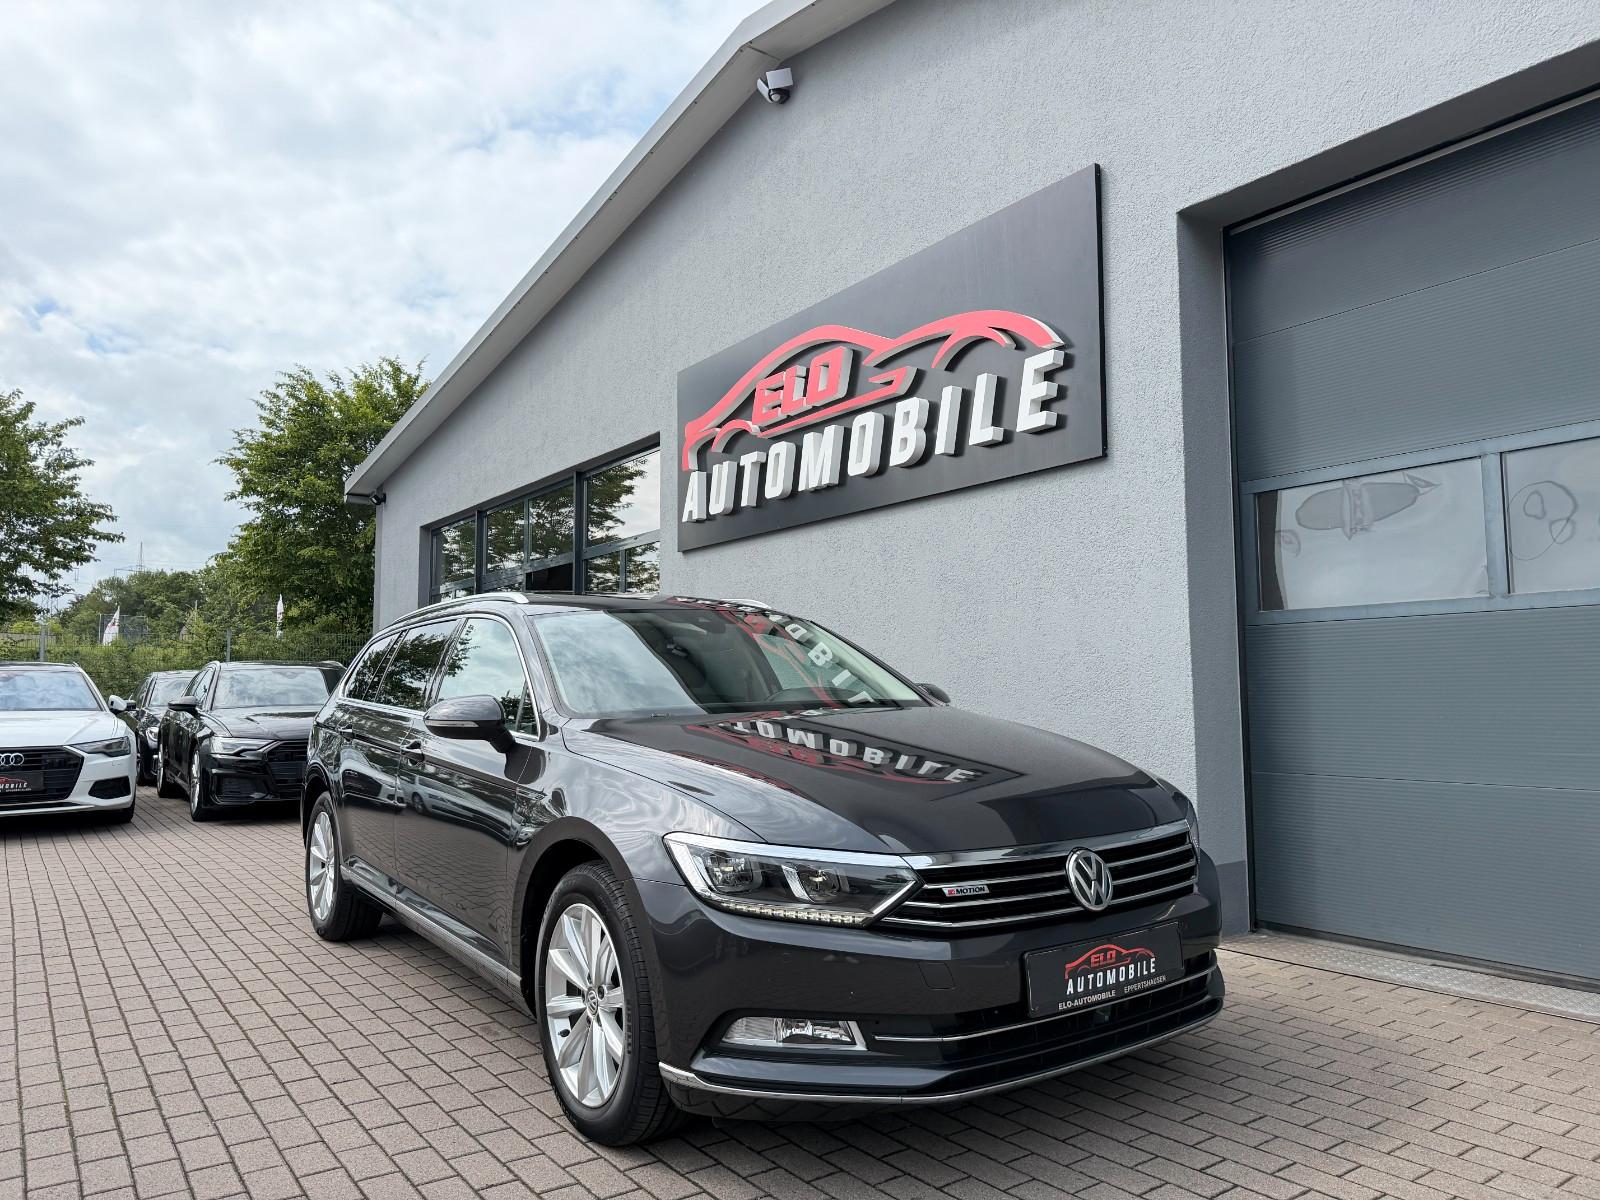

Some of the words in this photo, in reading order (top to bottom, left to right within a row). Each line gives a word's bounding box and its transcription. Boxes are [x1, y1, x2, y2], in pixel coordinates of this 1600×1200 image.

[751, 345, 853, 426] ELO
[682, 348, 1065, 523] AUTOMOBILE
[1066, 957, 1156, 995] AUTOMOBILE
[1090, 950, 1116, 968] ELO
[1058, 989, 1116, 1010] ELO-AUTOMOBILE
